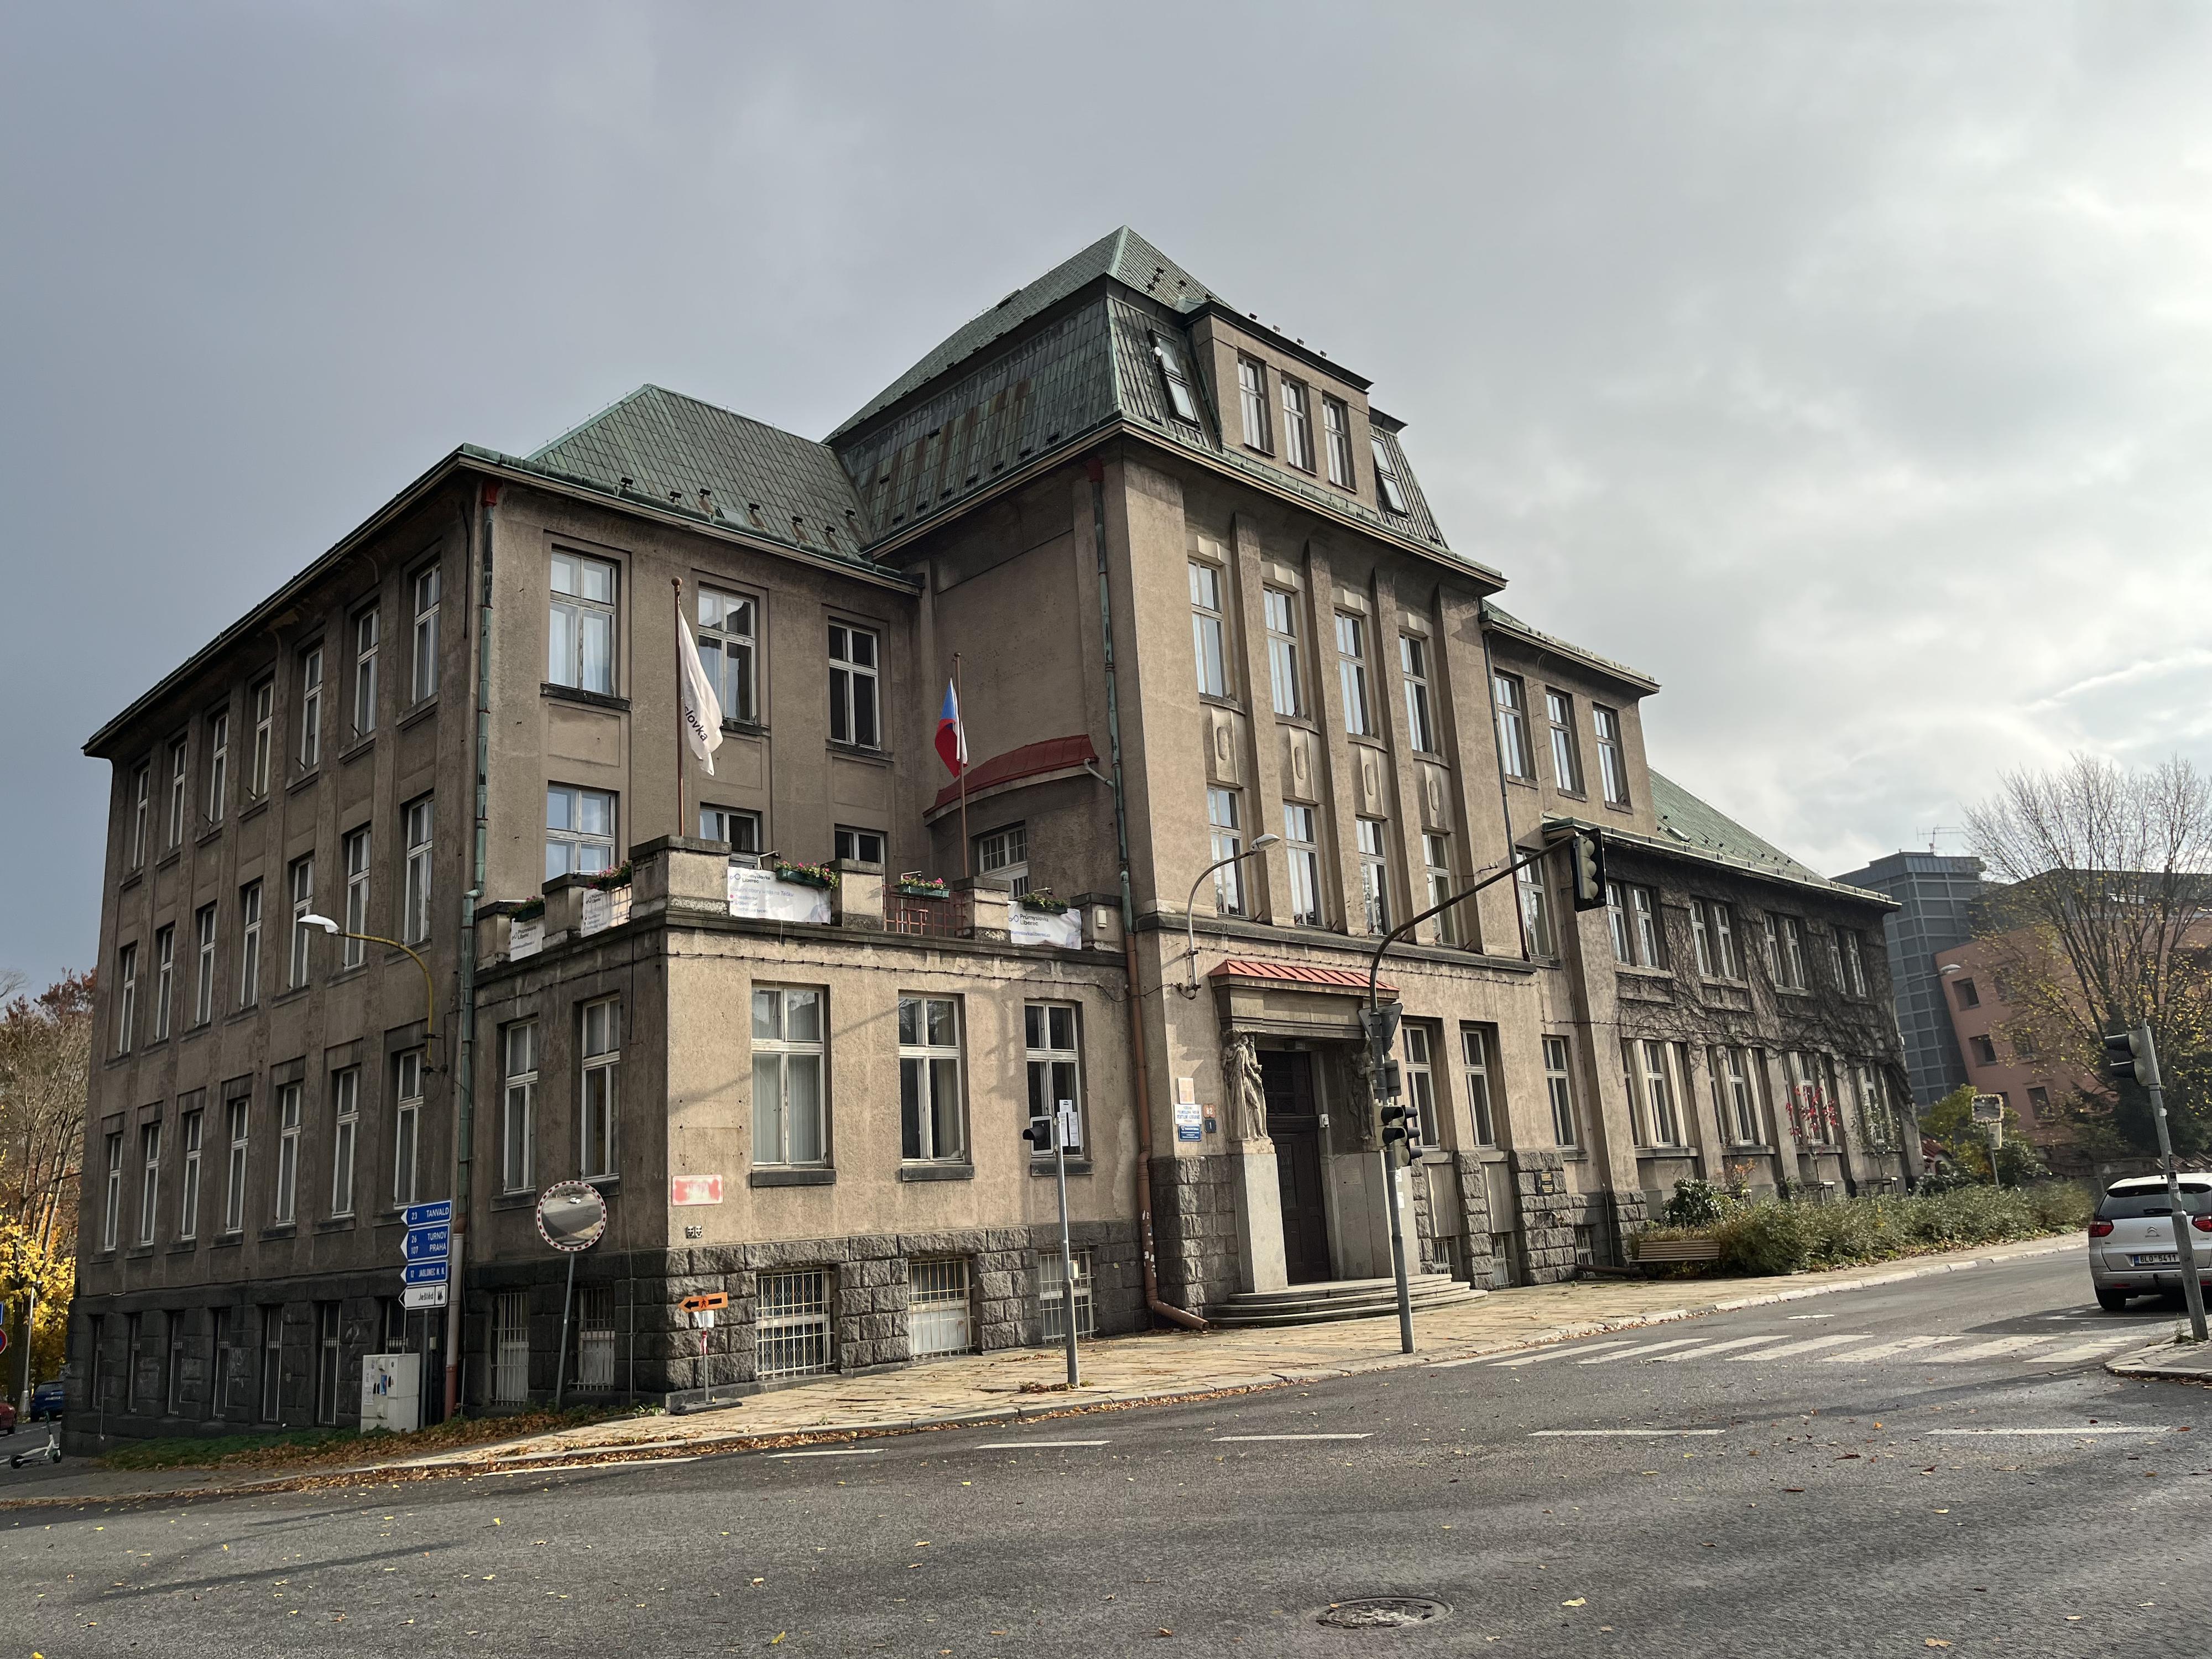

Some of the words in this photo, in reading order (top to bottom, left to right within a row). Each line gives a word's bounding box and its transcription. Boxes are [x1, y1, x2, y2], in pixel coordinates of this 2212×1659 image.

[411, 1212, 418, 1220] 23
[426, 1207, 449, 1218] TANVALD
[411, 1235, 417, 1244] 26
[427, 1231, 447, 1241] TURNOV
[430, 1243, 446, 1252] PRAHA
